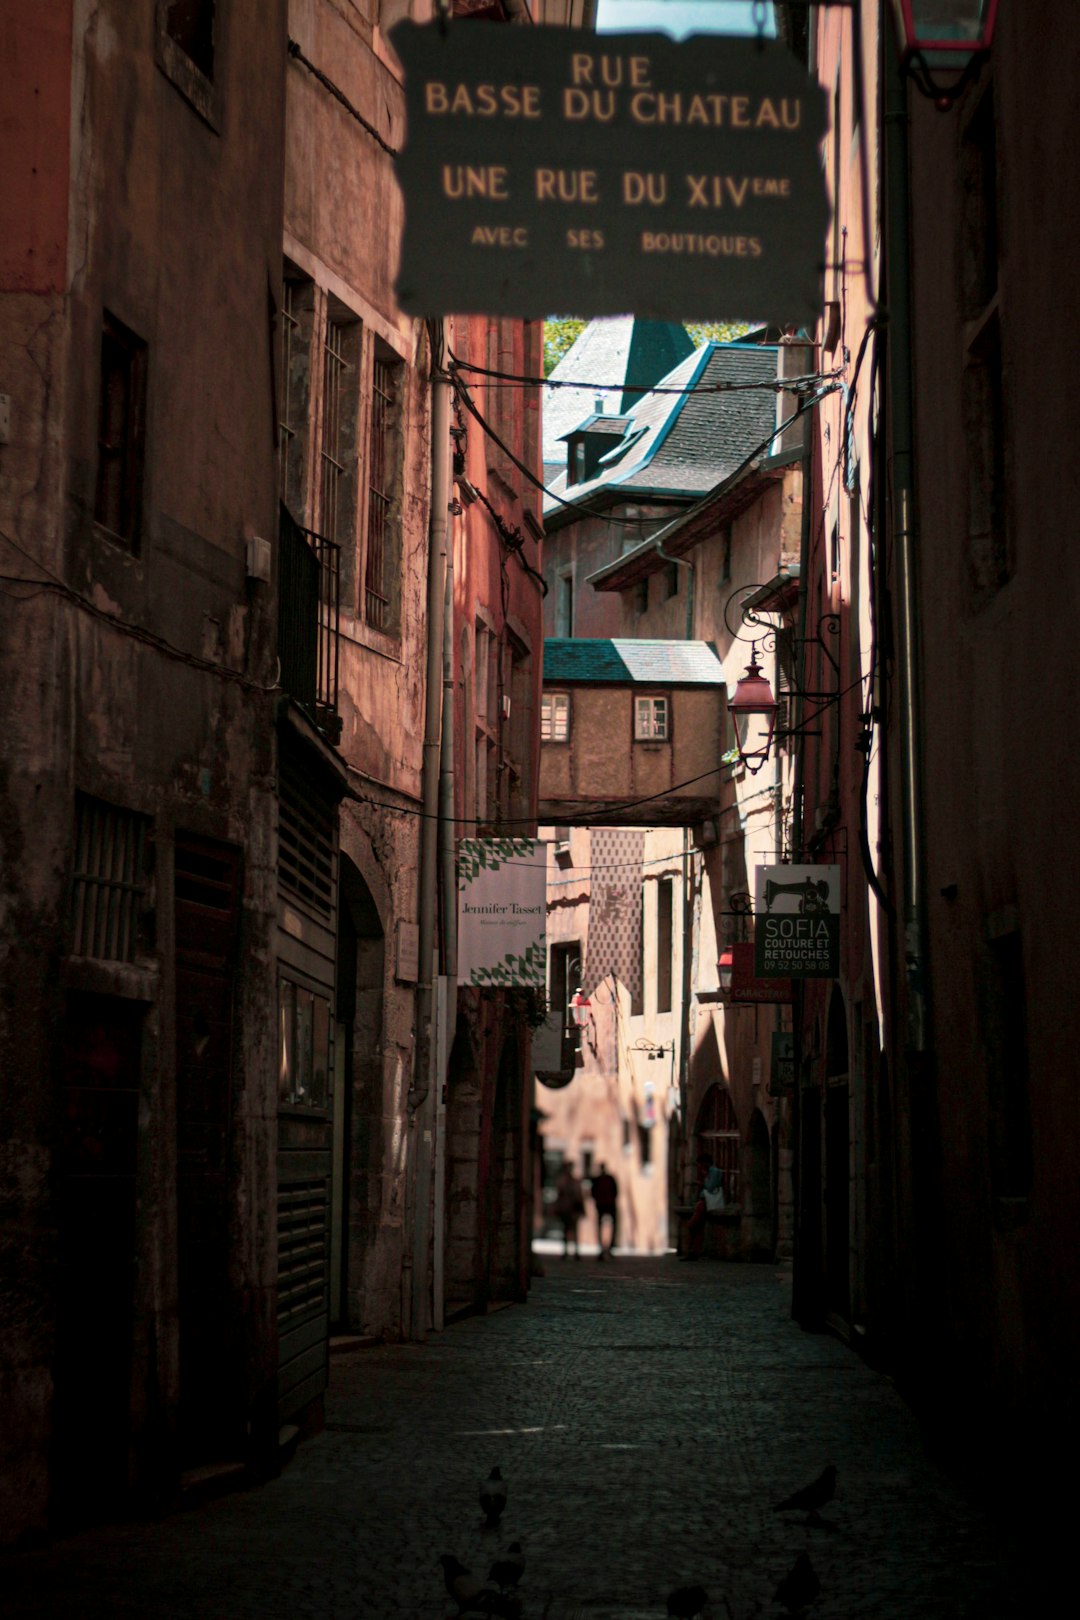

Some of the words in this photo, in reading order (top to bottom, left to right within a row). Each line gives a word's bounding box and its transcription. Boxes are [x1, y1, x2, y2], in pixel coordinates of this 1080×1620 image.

[572, 53, 651, 88] RUE
[424, 82, 541, 117] BASSE
[564, 87, 616, 122] DU
[630, 91, 802, 129] CHATEAU
[442, 165, 509, 199] UNE
[535, 169, 598, 204] RUE
[624, 172, 667, 205] DU
[472, 226, 528, 247] AVEC
[567, 228, 605, 249] SES
[641, 231, 763, 257] BOUTIQUES
[462, 903, 508, 914] Jennifer
[509, 903, 541, 914] Tasset
[765, 919, 830, 938] SOFIA
[764, 939, 814, 949] COUTURE
[816, 939, 830, 949] ET
[764, 949, 830, 960] RETOUCHES
[764, 960, 775, 970] 09
[777, 960, 789, 970] 52
[791, 960, 802, 970] 50
